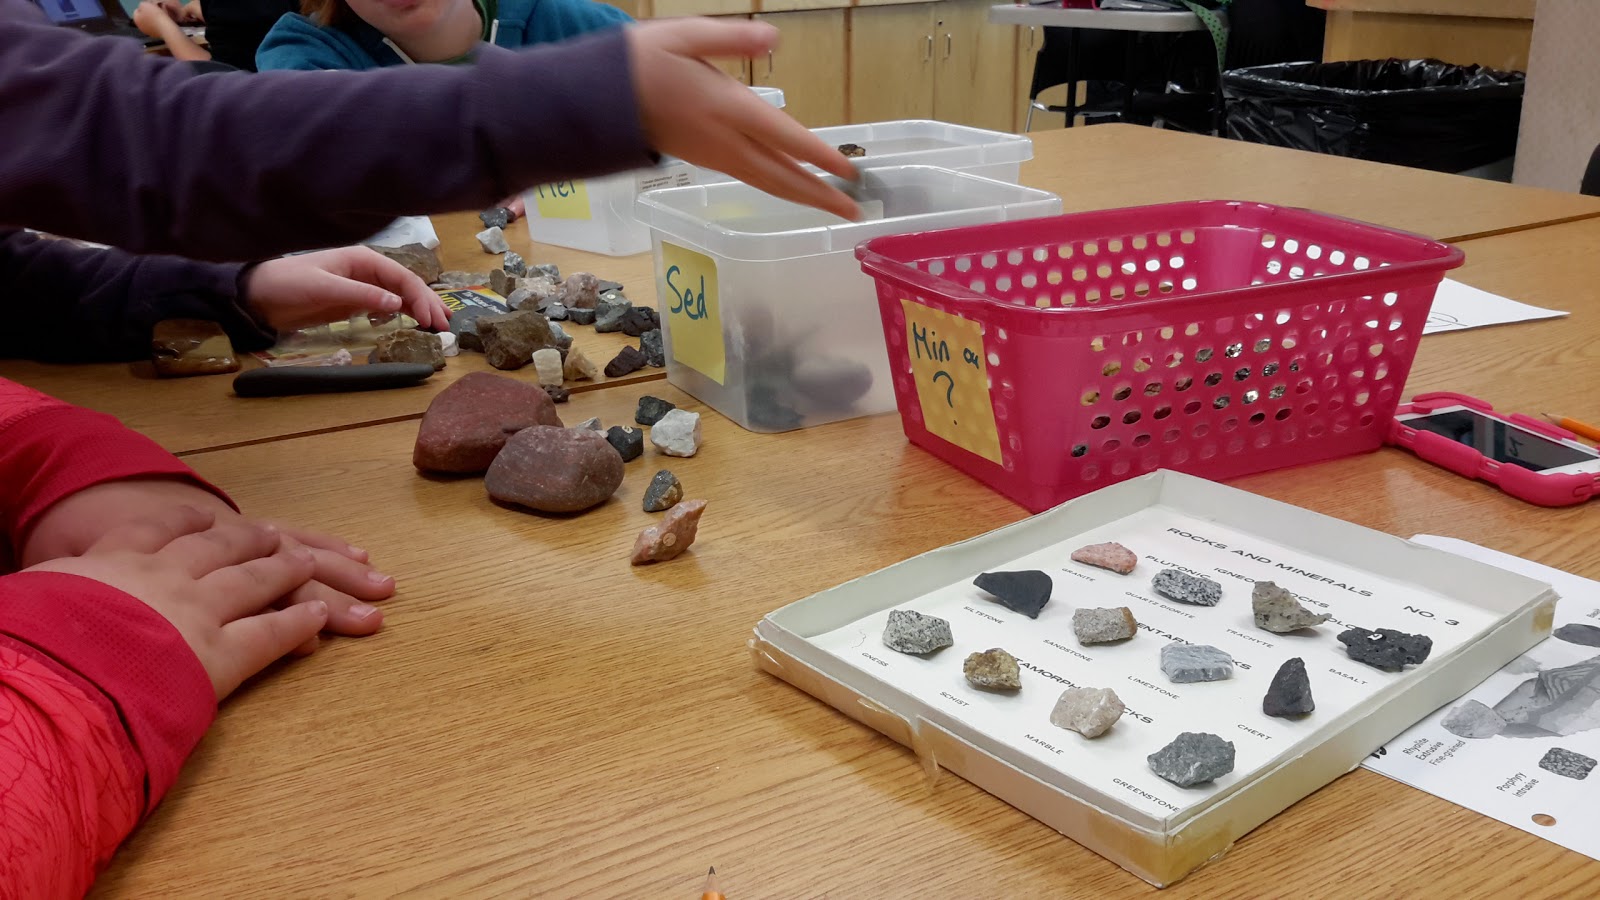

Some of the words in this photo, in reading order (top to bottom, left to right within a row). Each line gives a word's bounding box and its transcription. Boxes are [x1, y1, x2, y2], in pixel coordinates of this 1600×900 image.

[666, 265, 709, 321] Sed
[912, 322, 950, 362] Min
[933, 370, 958, 425] ?
[1145, 555, 1211, 579] PLUTONIC
[1167, 527, 1228, 549] ROCKS
[1231, 549, 1272, 564] AND
[1275, 563, 1373, 597] MINERALS
[1062, 568, 1096, 582] GRANITE
[1214, 567, 1256, 584] IGNEO
[1290, 592, 1330, 609] OCKS
[963, 606, 1004, 625] SILTSTONE
[1124, 591, 1157, 607] QUARTZ
[1159, 604, 1195, 619] DIORITE
[1403, 605, 1437, 621] NO.
[1445, 618, 1460, 627] 3
[1137, 622, 1195, 645] ENTARY
[1226, 628, 1274, 649] TRACHYTE
[861, 652, 889, 667] GNEISS
[1042, 639, 1093, 663] SANDSTONE
[1127, 676, 1180, 700] LIMESTONE
[1328, 668, 1368, 685] BASALT
[939, 691, 970, 707] SCHIST
[1015, 657, 1082, 690] TAMORPH
[1123, 707, 1154, 724] CKS
[1237, 724, 1272, 740] CHERT
[1024, 733, 1064, 755] MARBLE
[1402, 738, 1429, 755] Rhyolite
[1415, 741, 1444, 760] Extrusive
[1428, 739, 1466, 766] Fine-grained
[1112, 777, 1181, 813] GREENSTONE
